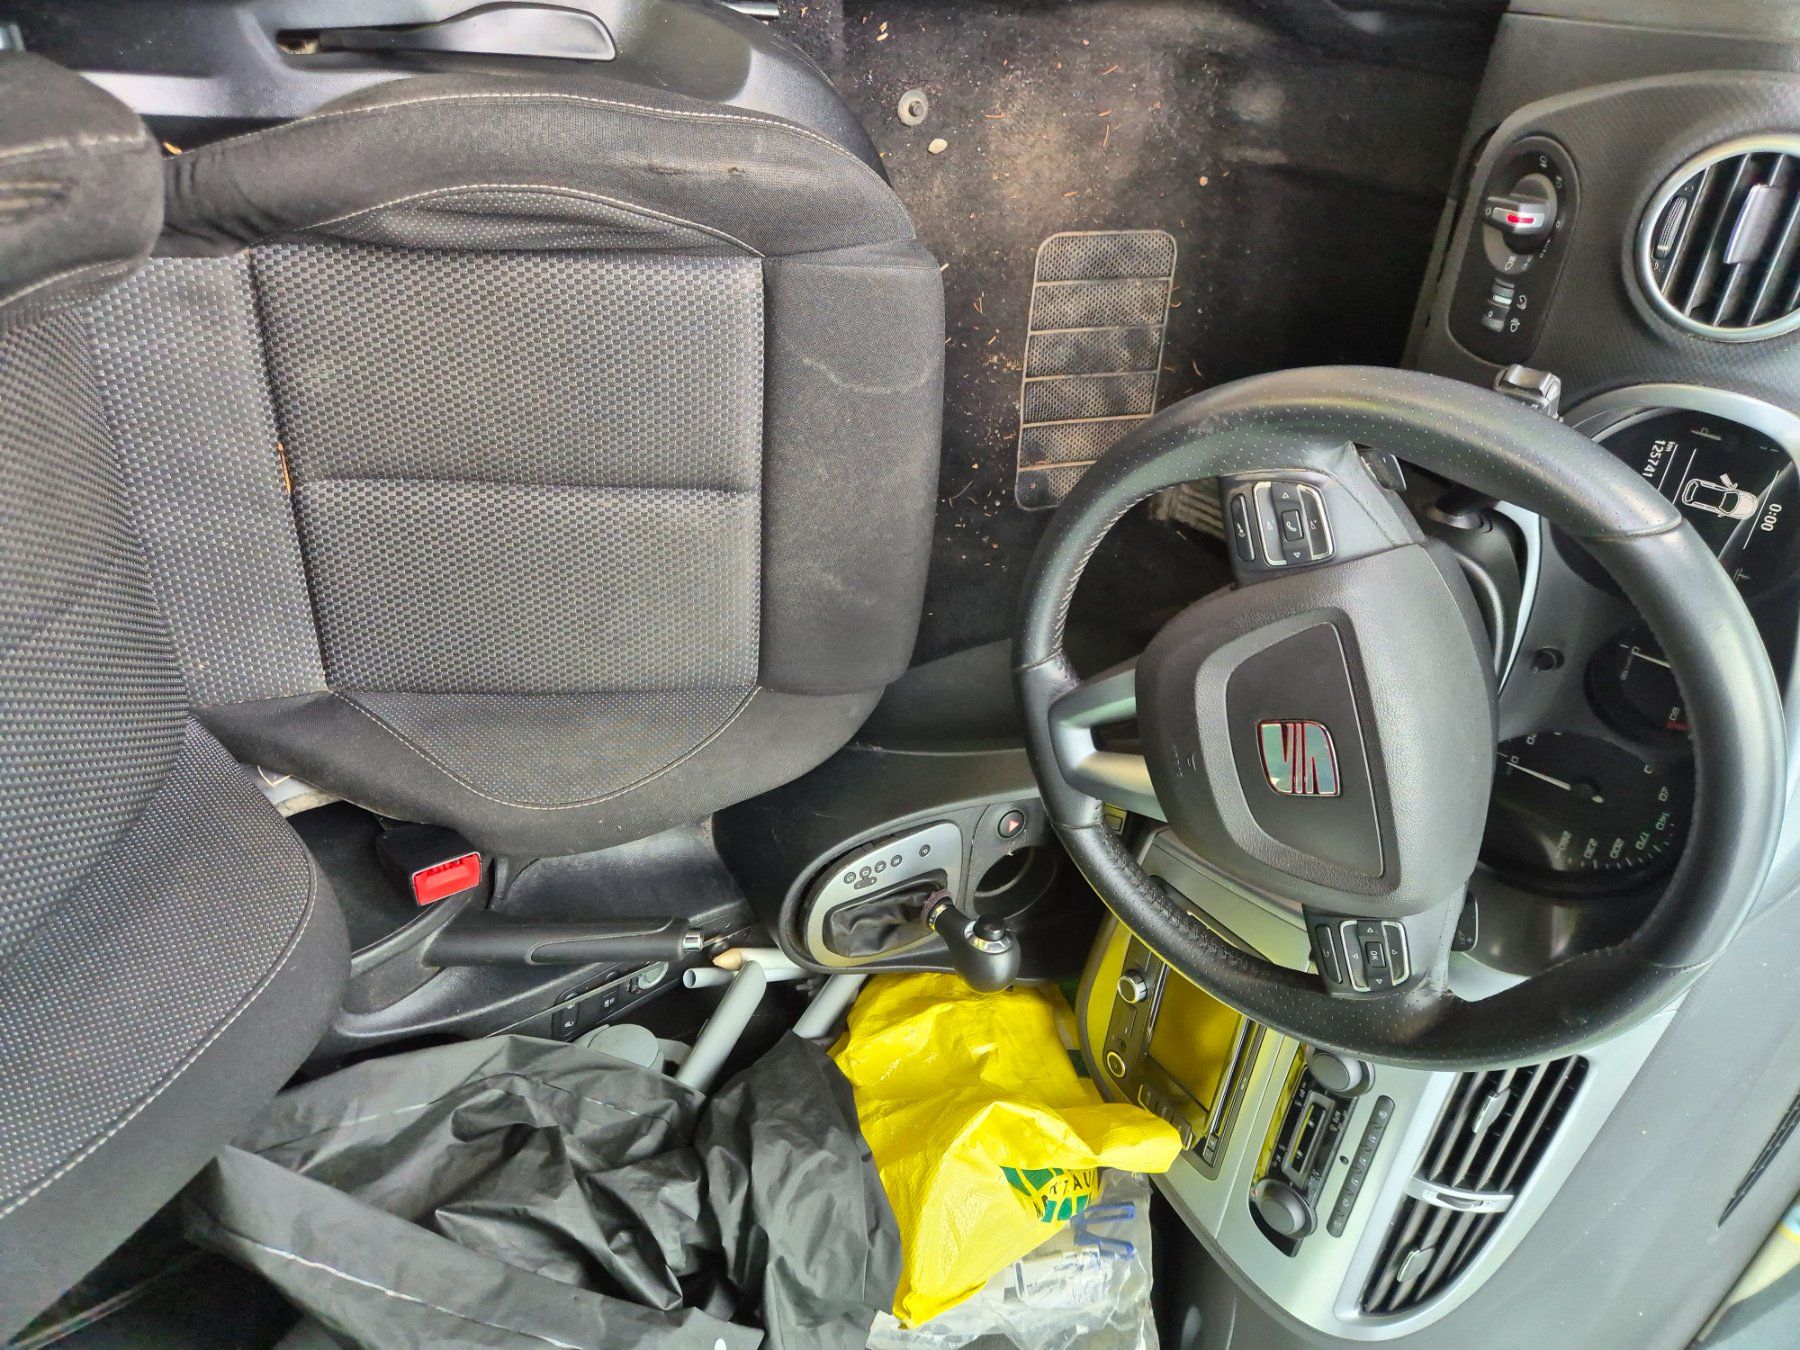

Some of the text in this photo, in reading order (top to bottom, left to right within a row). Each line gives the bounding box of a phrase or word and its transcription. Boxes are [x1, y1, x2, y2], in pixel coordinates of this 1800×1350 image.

[1665, 441, 1676, 452] km
[1642, 440, 1666, 478] 125741
[1760, 503, 1782, 532] 0:00
[1609, 838, 1624, 859] 200
[1635, 832, 1650, 850] 170
[1369, 950, 1379, 961] OK
